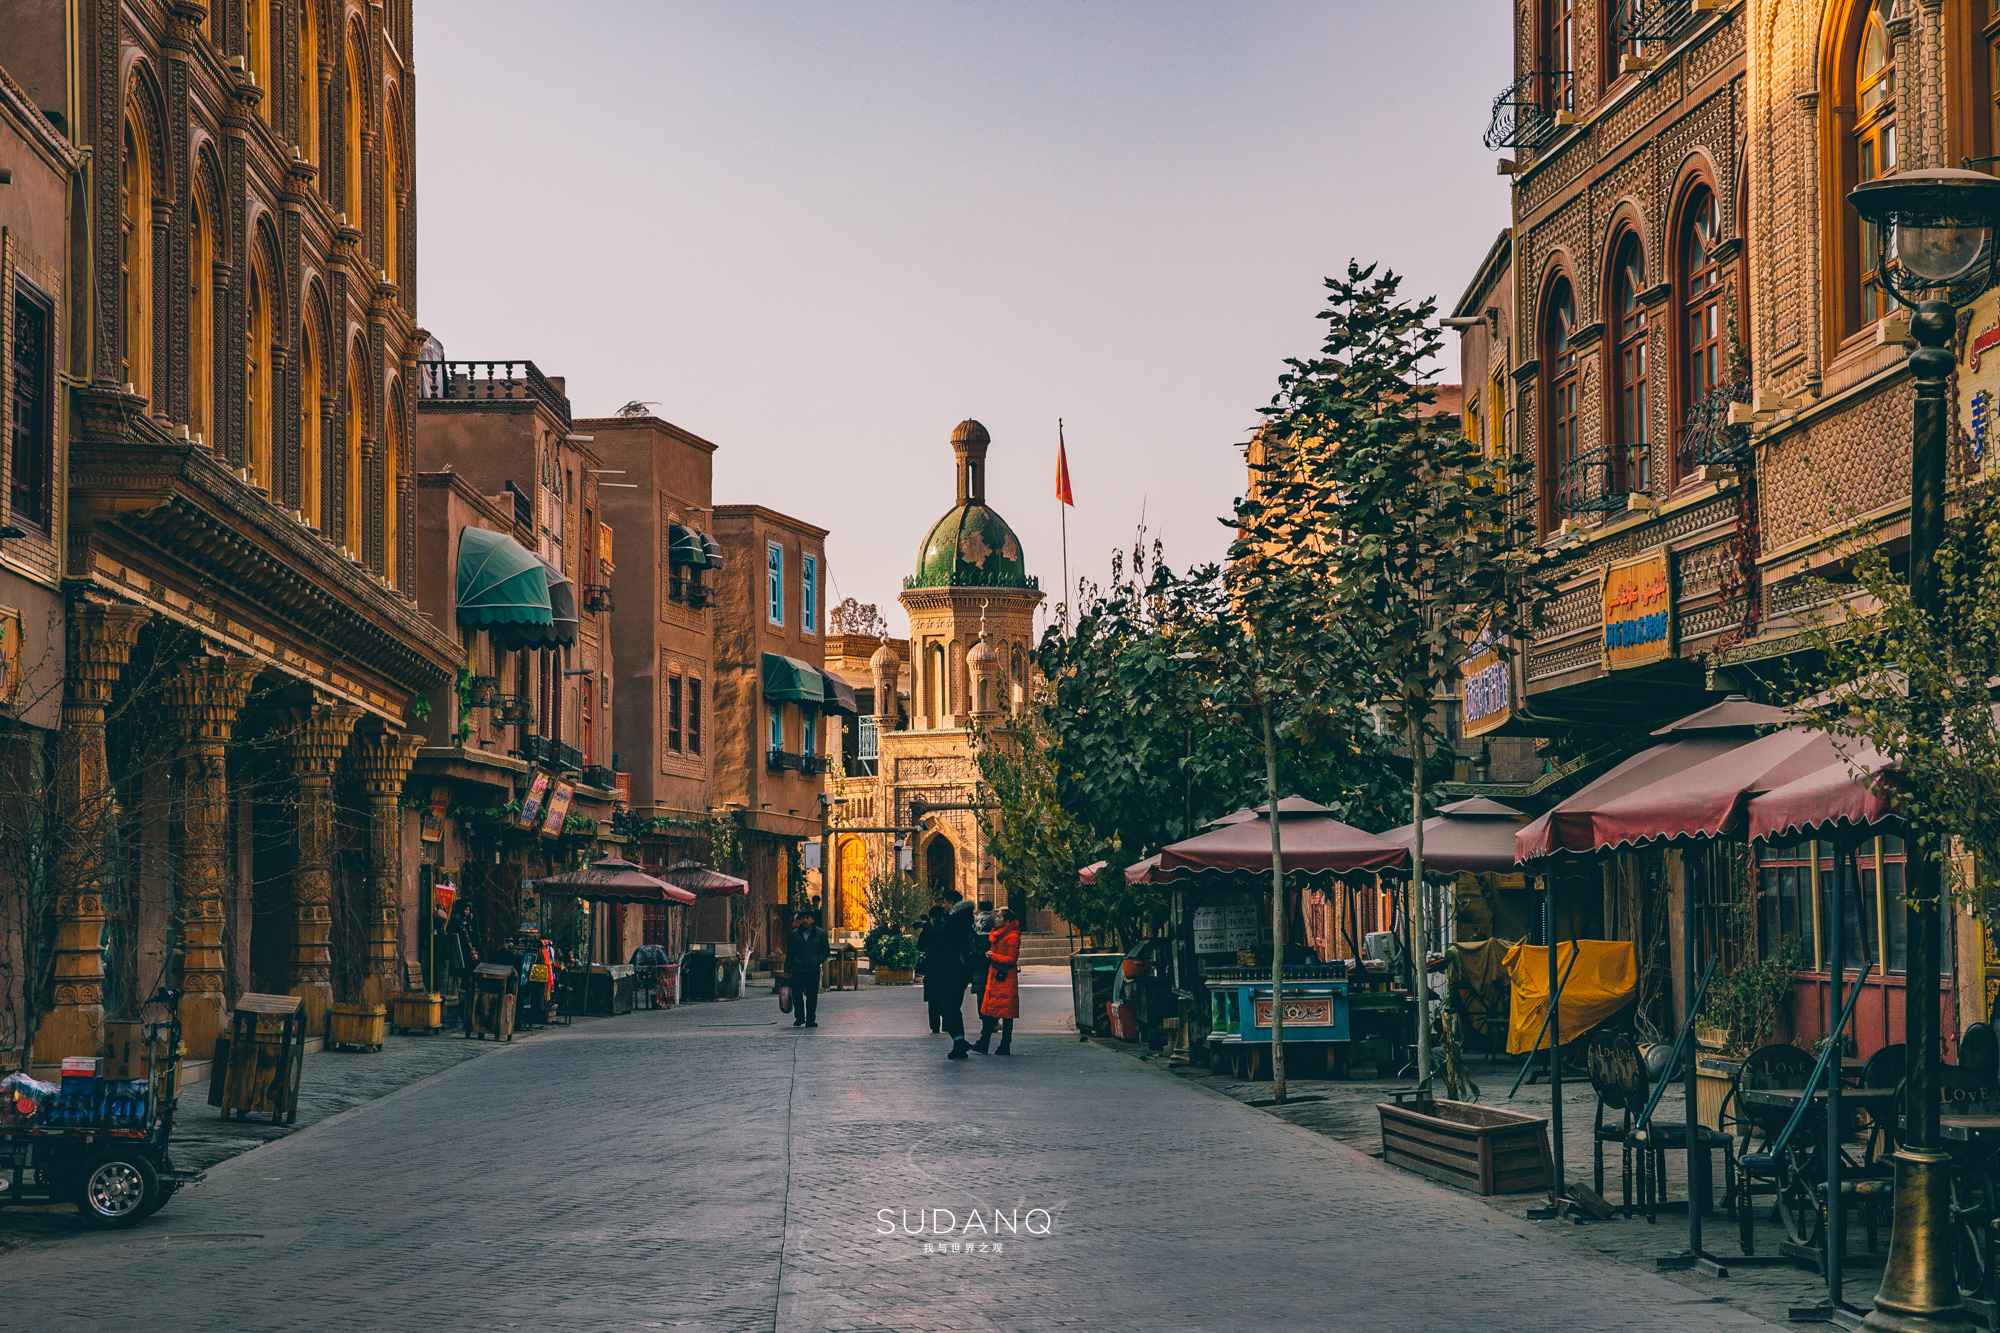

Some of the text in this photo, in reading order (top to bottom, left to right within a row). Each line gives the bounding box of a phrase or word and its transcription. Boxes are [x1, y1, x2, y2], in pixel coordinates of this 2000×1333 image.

[1229, 918, 1255, 926] 有牛奶
[1763, 1060, 1806, 1076] LOVE
[1940, 1086, 1990, 1104] LOVE
